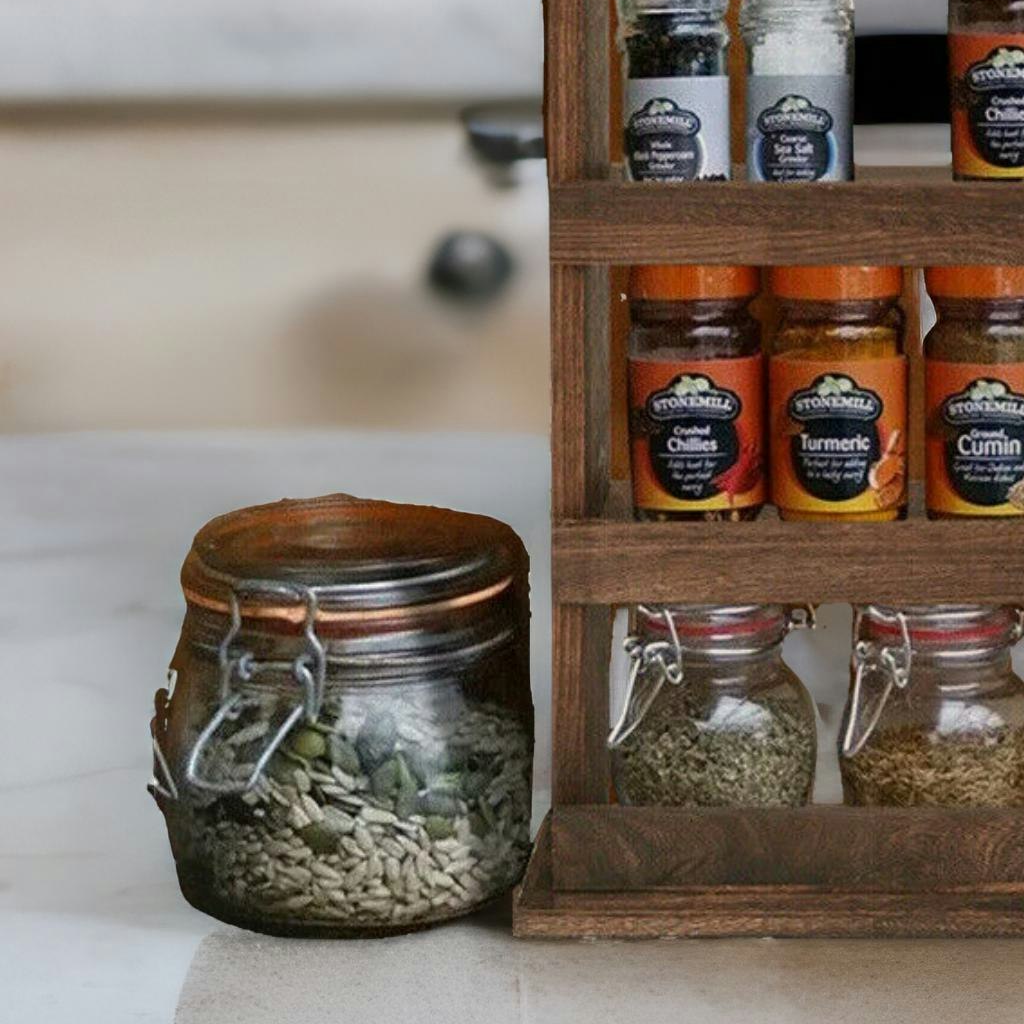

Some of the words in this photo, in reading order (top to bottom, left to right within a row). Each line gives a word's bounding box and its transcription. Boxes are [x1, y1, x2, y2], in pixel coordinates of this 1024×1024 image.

[773, 143, 792, 155] Sea
[794, 143, 814, 155] Salt
[653, 396, 733, 413] STONEMILL
[795, 396, 875, 412] STONEMILL
[673, 425, 711, 436] Crushed
[970, 427, 1006, 439] Ground
[667, 437, 718, 452] Chillies
[801, 433, 870, 451] Turmeric
[957, 434, 1022, 456] Cumin
